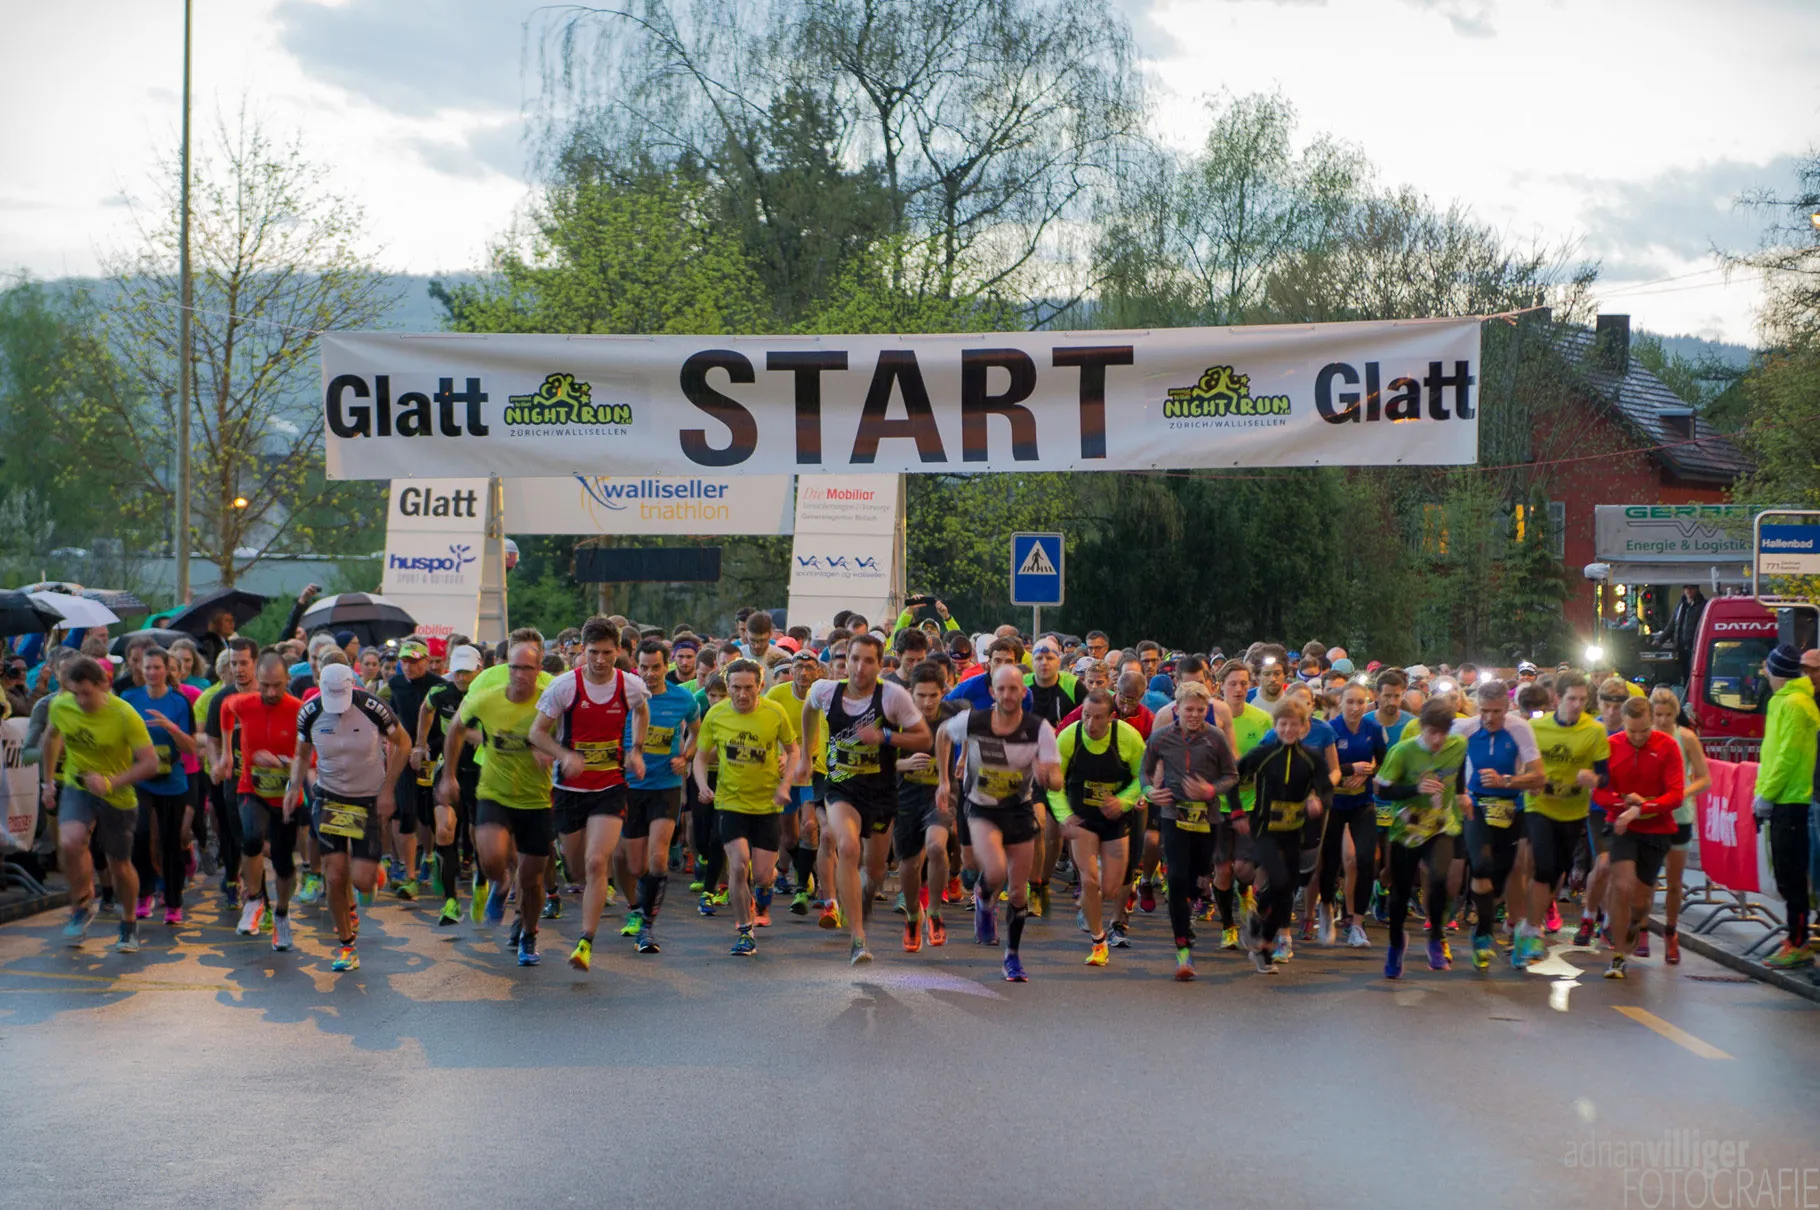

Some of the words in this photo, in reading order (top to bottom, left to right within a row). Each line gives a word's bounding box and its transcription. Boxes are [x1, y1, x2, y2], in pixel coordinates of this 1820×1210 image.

[1315, 360, 1476, 424] Glatt
[327, 374, 489, 438] Glatt
[679, 345, 1134, 467] START
[1164, 399, 1228, 418] NIGHT
[505, 407, 569, 425] NIGHT
[1169, 419, 1286, 429] ZÜRICH/WALLISELLEN
[510, 428, 628, 437] ZÜRICH/WALLISELLEN
[604, 480, 729, 499] walliseller
[803, 487, 824, 500] Die
[826, 488, 875, 500] Mobiliar
[400, 487, 478, 518] Glatt
[640, 501, 729, 520] triathlon
[1626, 540, 1676, 553] Energie
[1681, 540, 1690, 550] &
[1695, 539, 1747, 553] Logistik
[1762, 538, 1813, 548] Hallenbad
[390, 554, 454, 573] huspo
